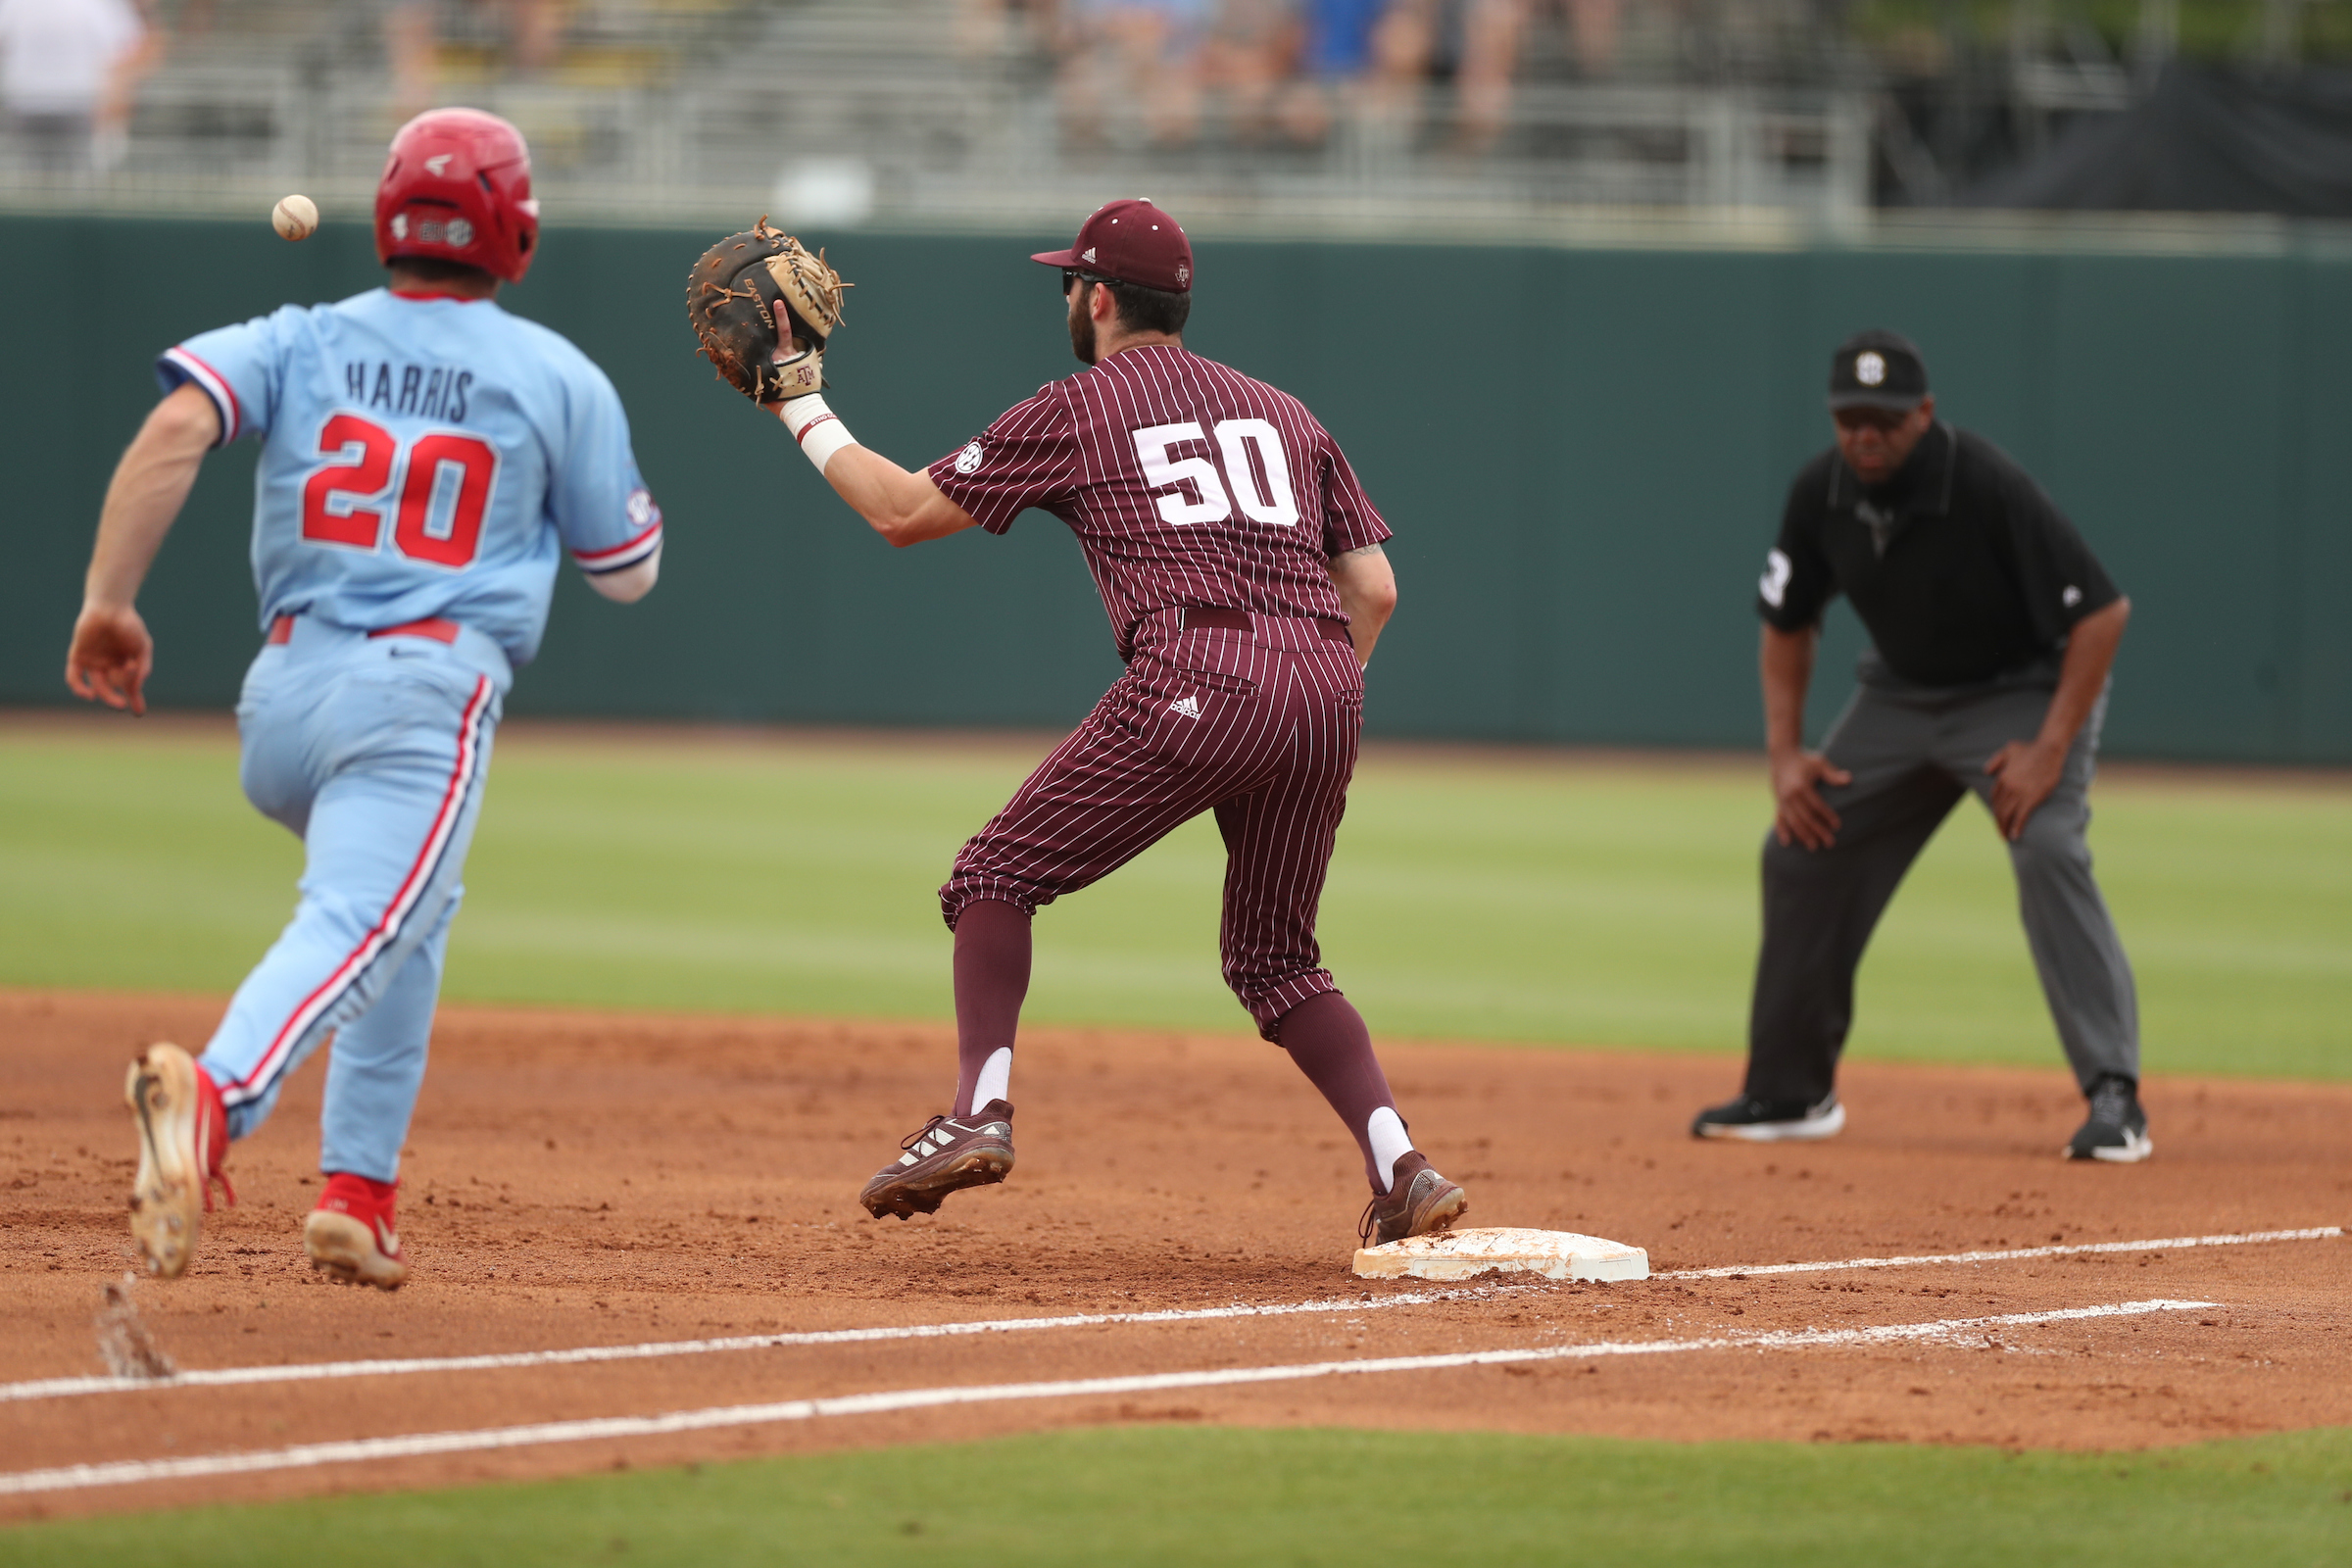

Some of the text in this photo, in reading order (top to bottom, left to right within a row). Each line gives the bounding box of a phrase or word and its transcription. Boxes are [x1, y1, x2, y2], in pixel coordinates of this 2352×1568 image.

[744, 278, 775, 329] EASTON
[346, 361, 473, 423] HARRIS
[298, 408, 502, 575] 20
[1132, 418, 1299, 527] 50
[1170, 703, 1201, 720] adidas
